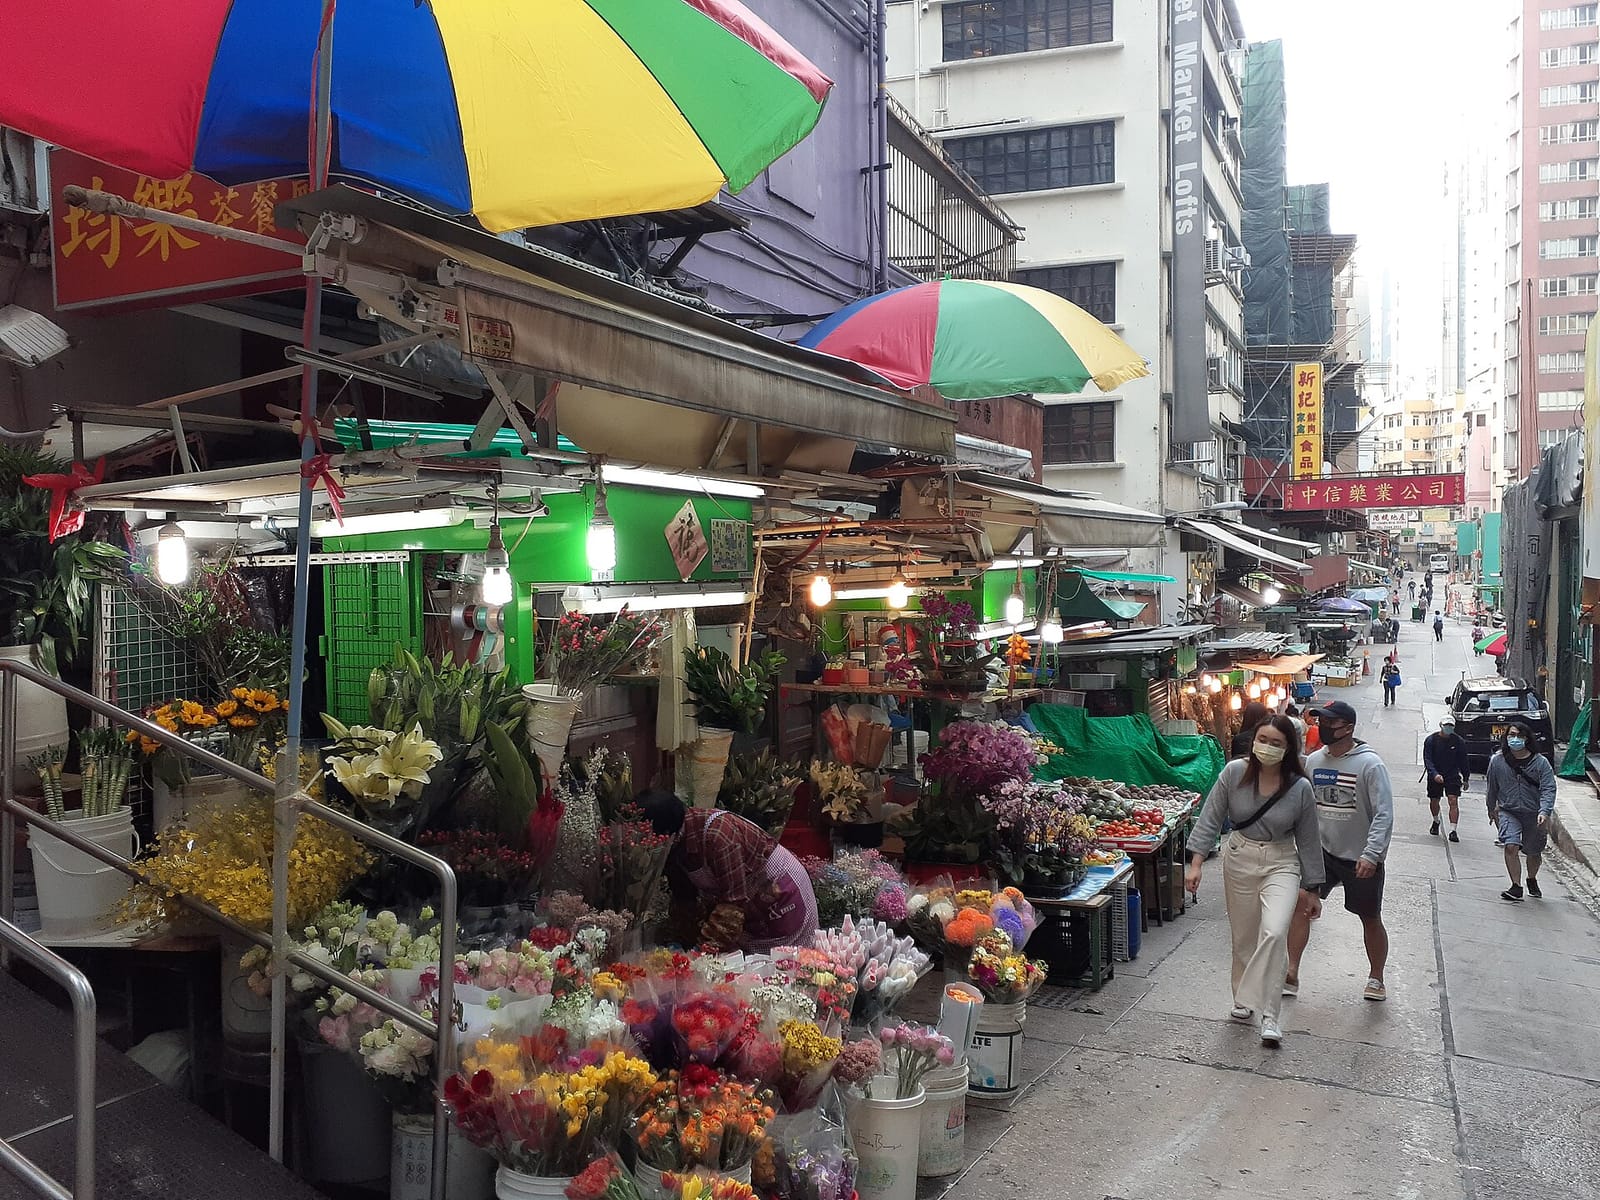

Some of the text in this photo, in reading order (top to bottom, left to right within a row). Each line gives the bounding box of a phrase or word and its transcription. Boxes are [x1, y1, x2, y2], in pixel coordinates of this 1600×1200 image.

[1174, 41, 1198, 145] Market
[1174, 163, 1198, 235] Lofts
[1297, 370, 1316, 409] 新記
[1301, 480, 1446, 505] 中信藥業公司
